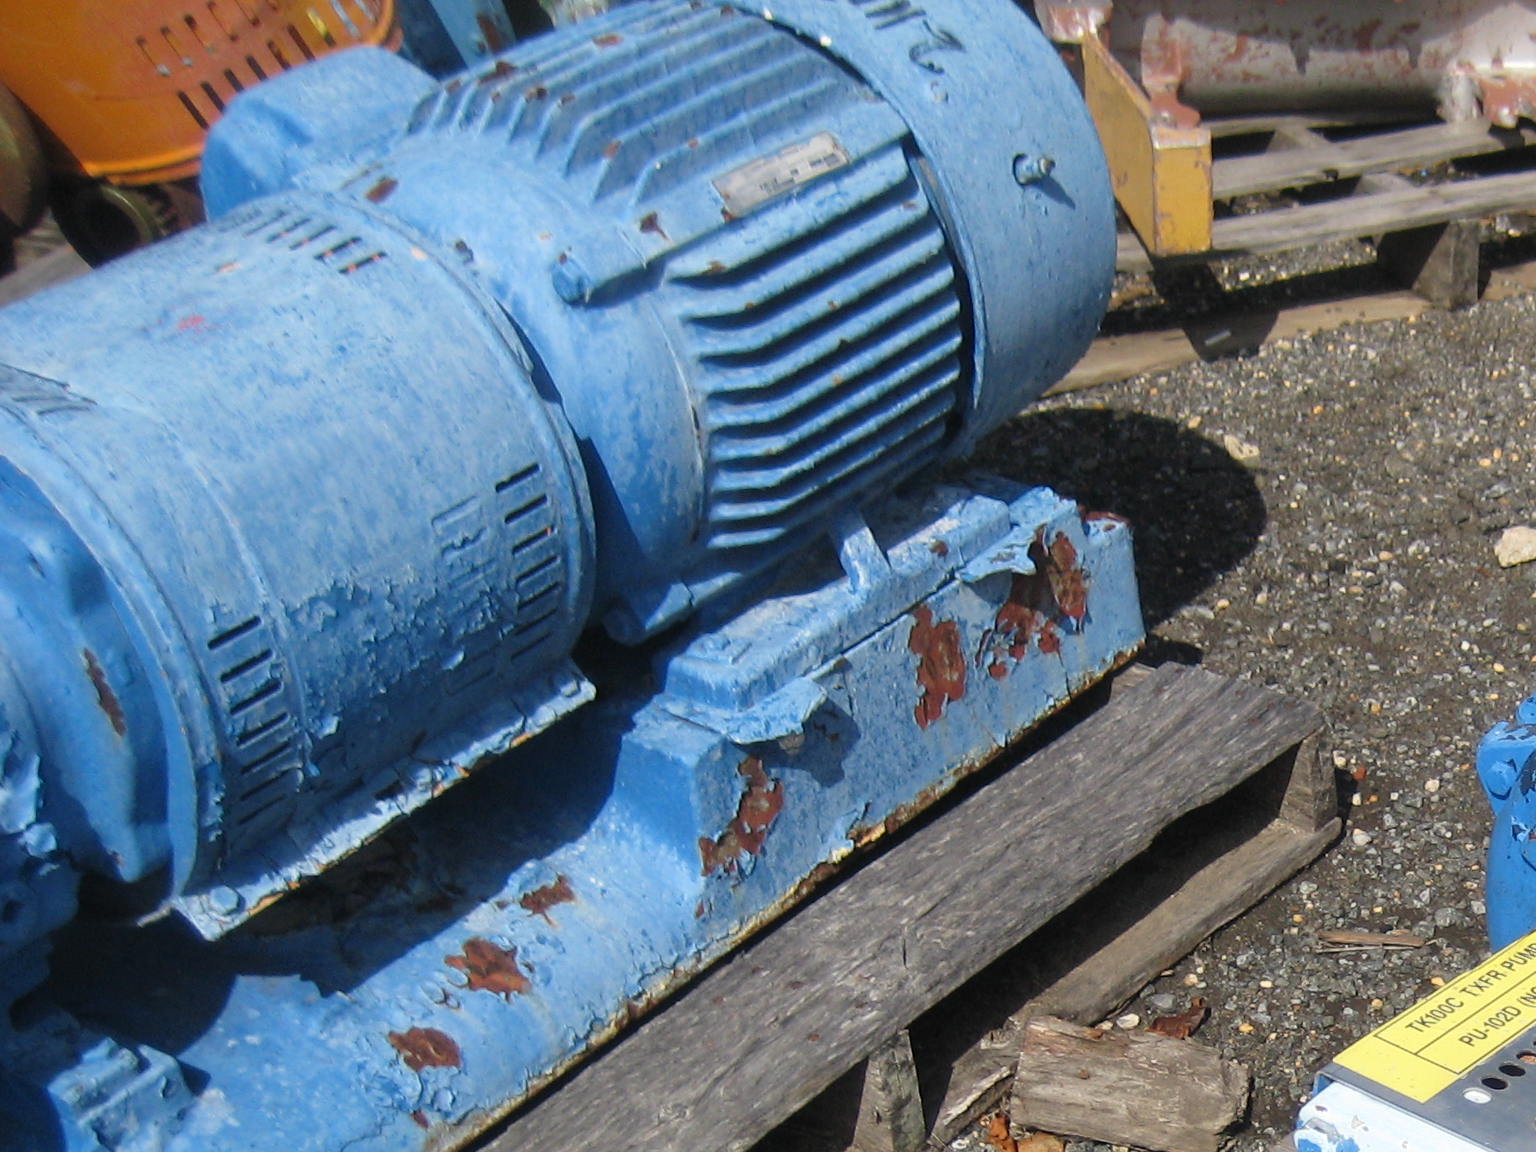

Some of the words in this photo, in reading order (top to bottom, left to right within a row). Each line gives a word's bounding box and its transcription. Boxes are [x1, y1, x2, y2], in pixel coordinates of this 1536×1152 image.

[1405, 997, 1464, 1034] TK100C
[1459, 969, 1507, 997] TXFR
[1458, 1006, 1522, 1047] PU-102D
